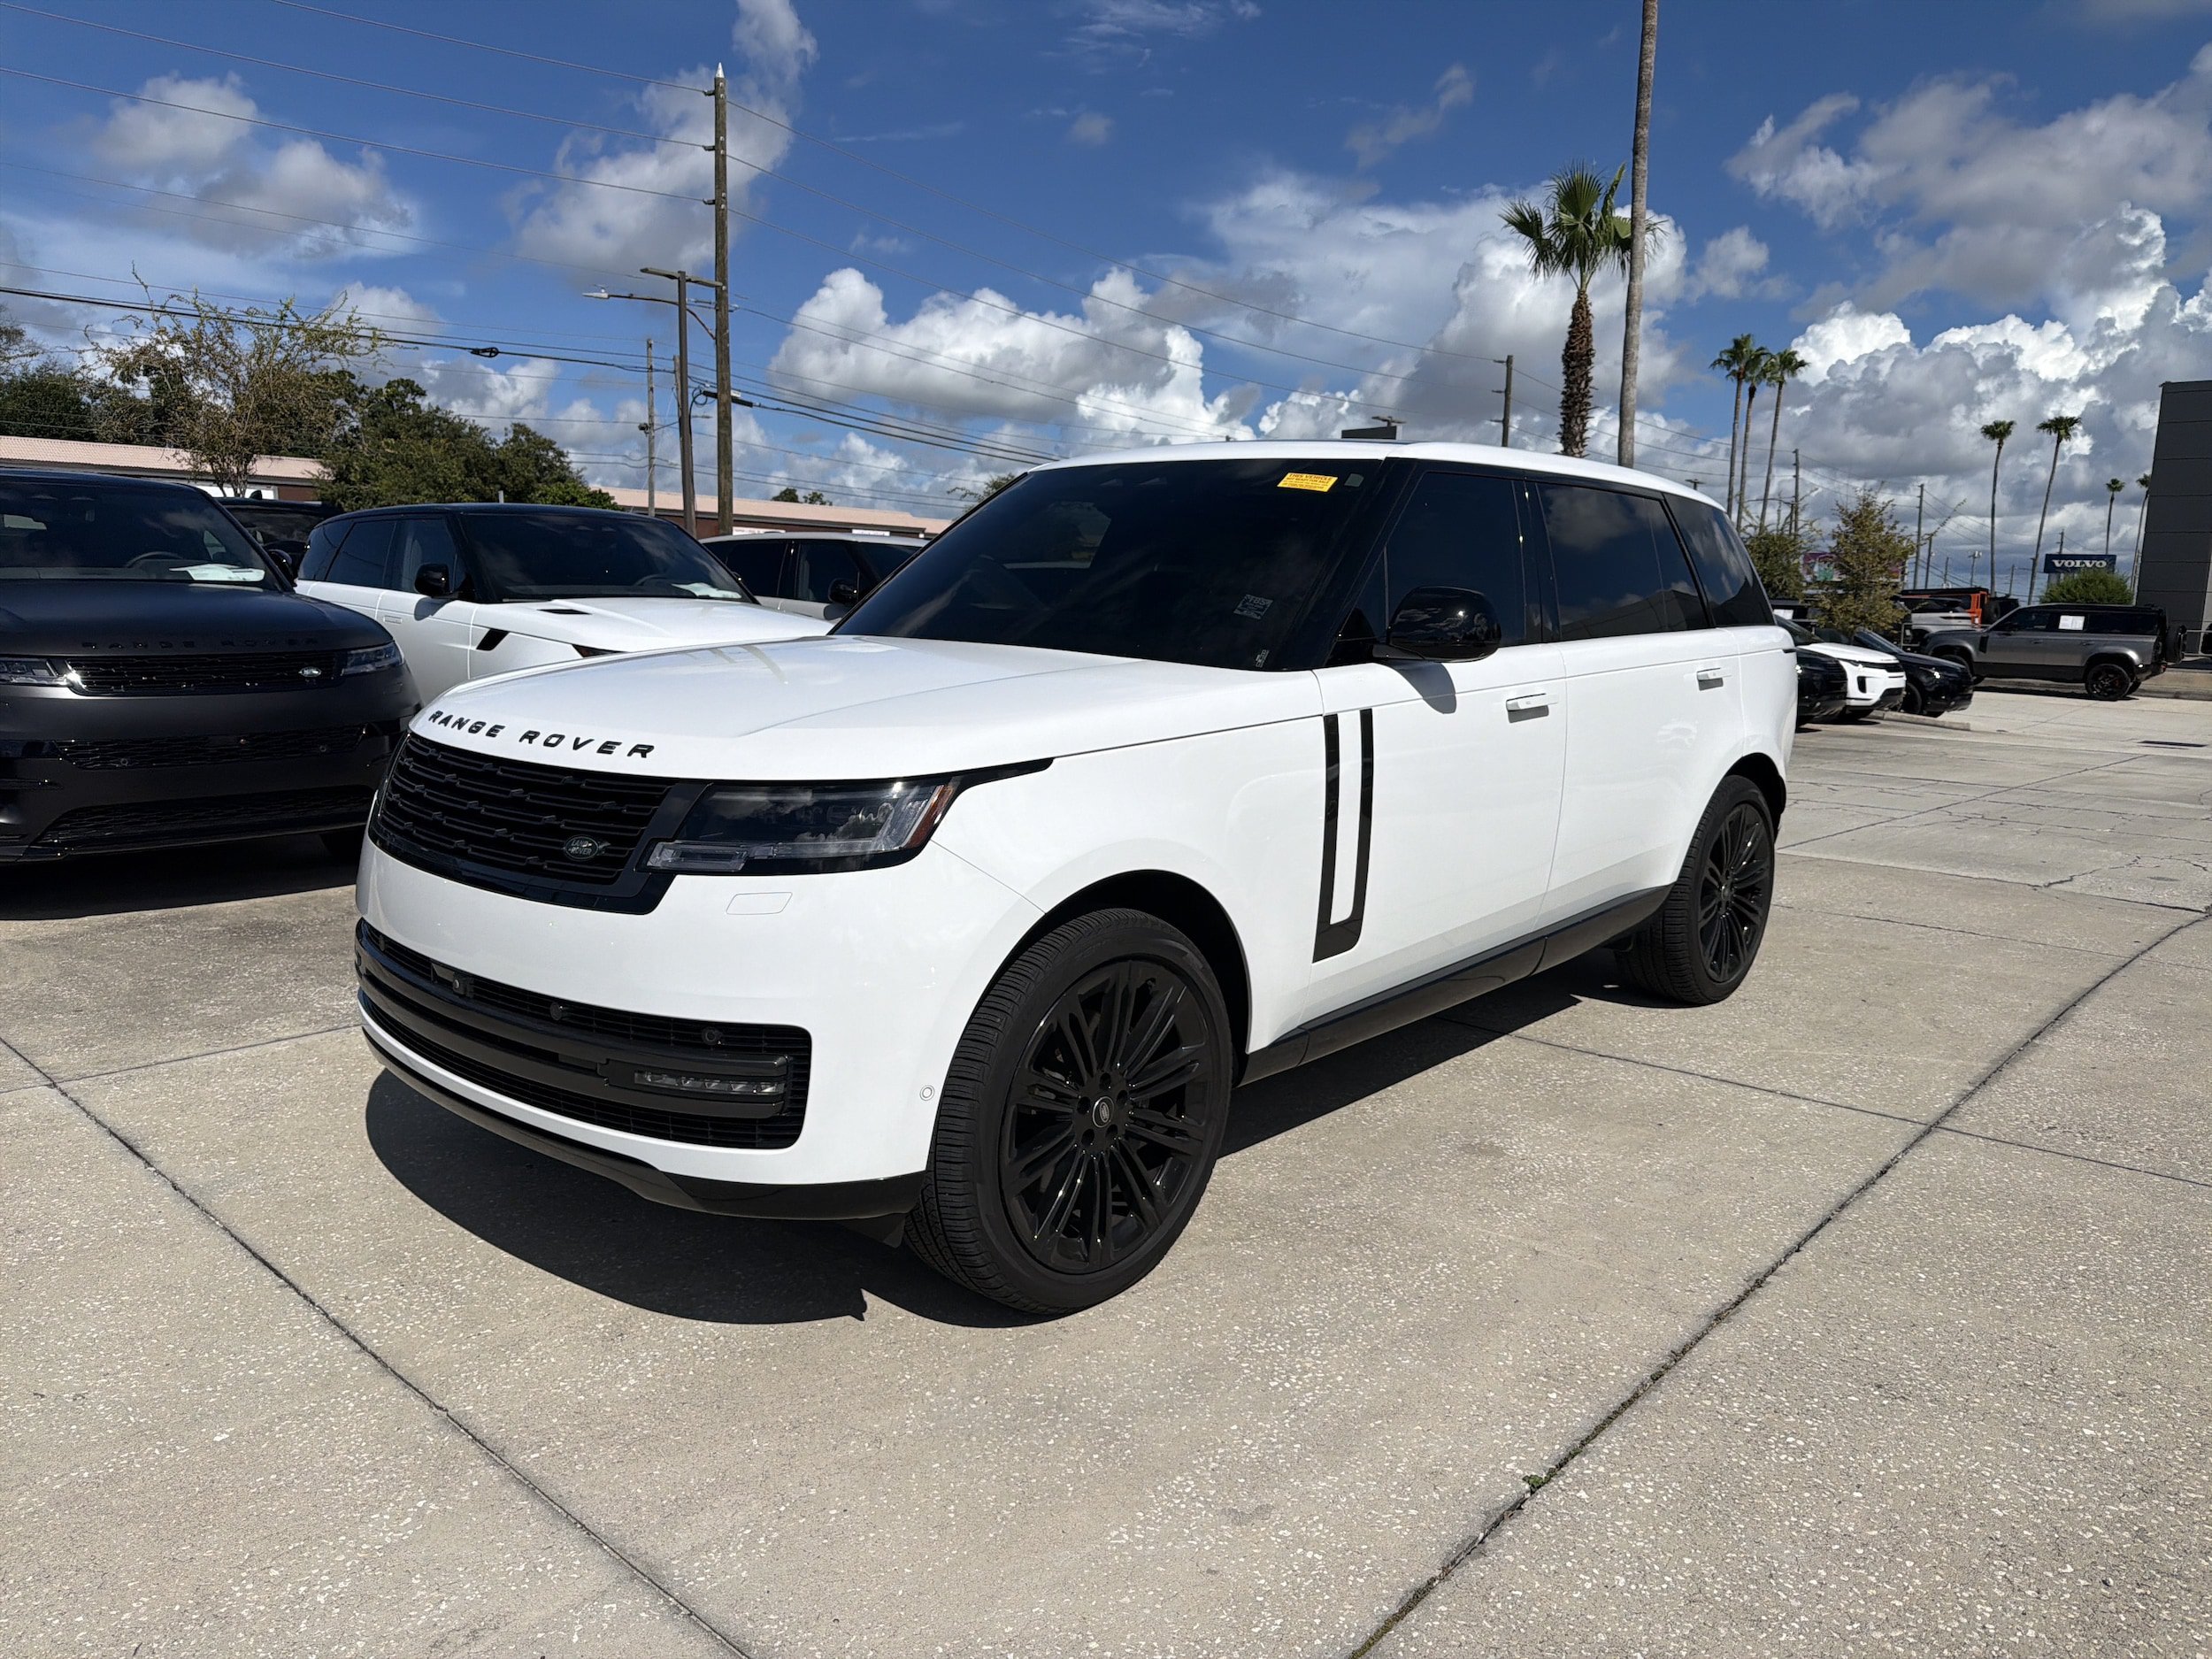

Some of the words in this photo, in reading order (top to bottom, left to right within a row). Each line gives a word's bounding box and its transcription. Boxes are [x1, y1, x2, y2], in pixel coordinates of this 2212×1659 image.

[428, 710, 505, 738] RANGE
[518, 730, 655, 758] ROVER
[570, 847, 593, 856] ROVER
